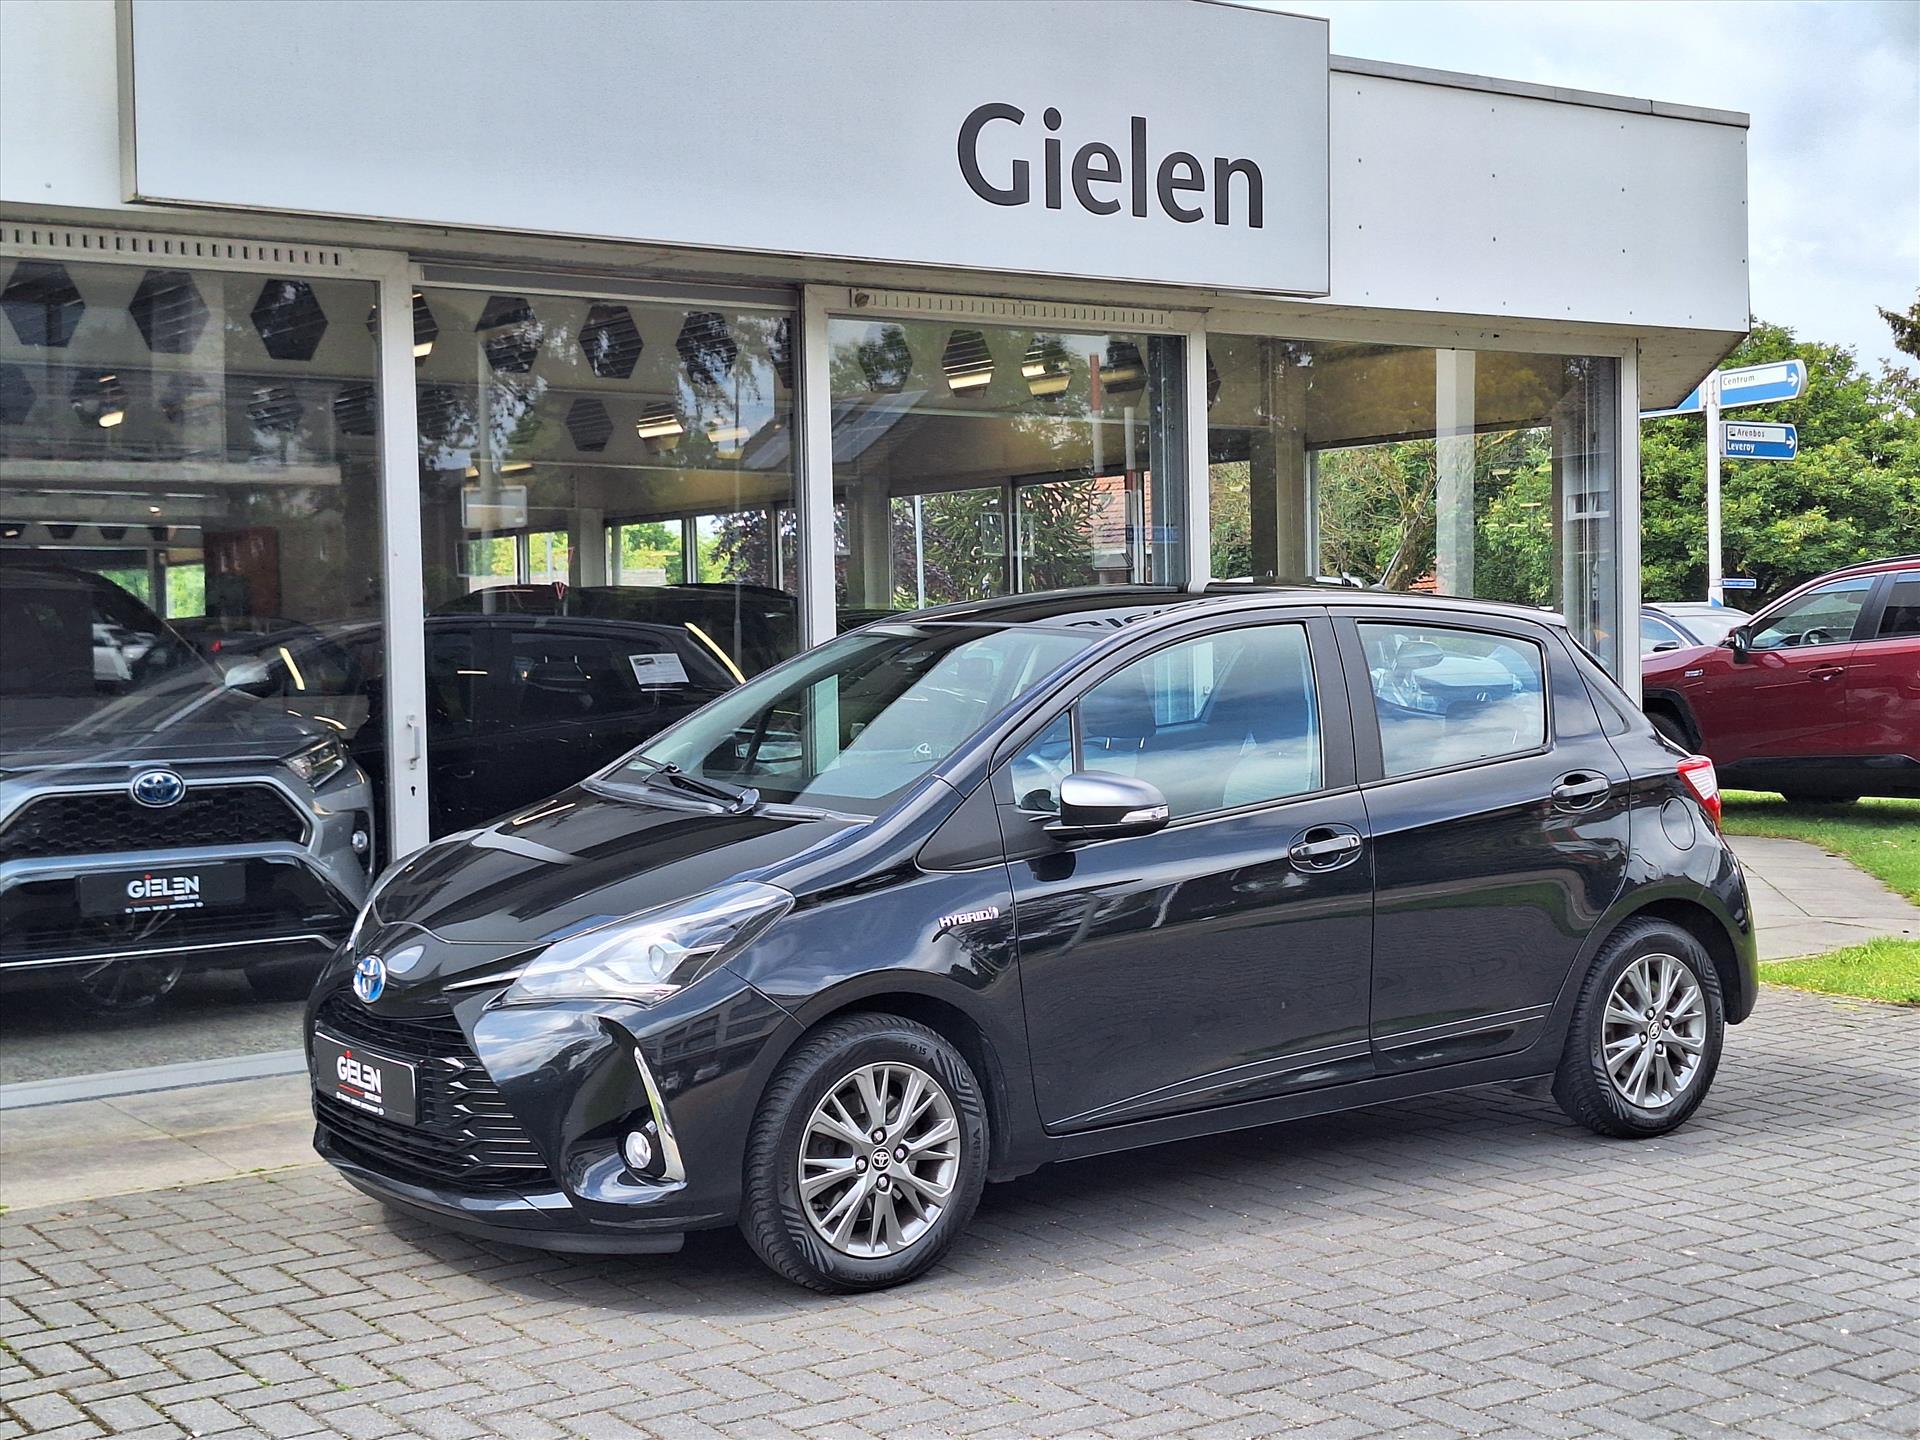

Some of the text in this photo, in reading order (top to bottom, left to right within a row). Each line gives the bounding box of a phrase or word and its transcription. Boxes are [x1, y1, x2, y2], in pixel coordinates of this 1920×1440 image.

[957, 102, 1263, 228] Gielen
[1723, 375, 1755, 386] Centrum
[1727, 440, 1755, 454] Leveroy
[127, 873, 200, 898] GIELEN
[939, 909, 992, 928] HYBRID
[337, 1049, 382, 1094] GIELEN
